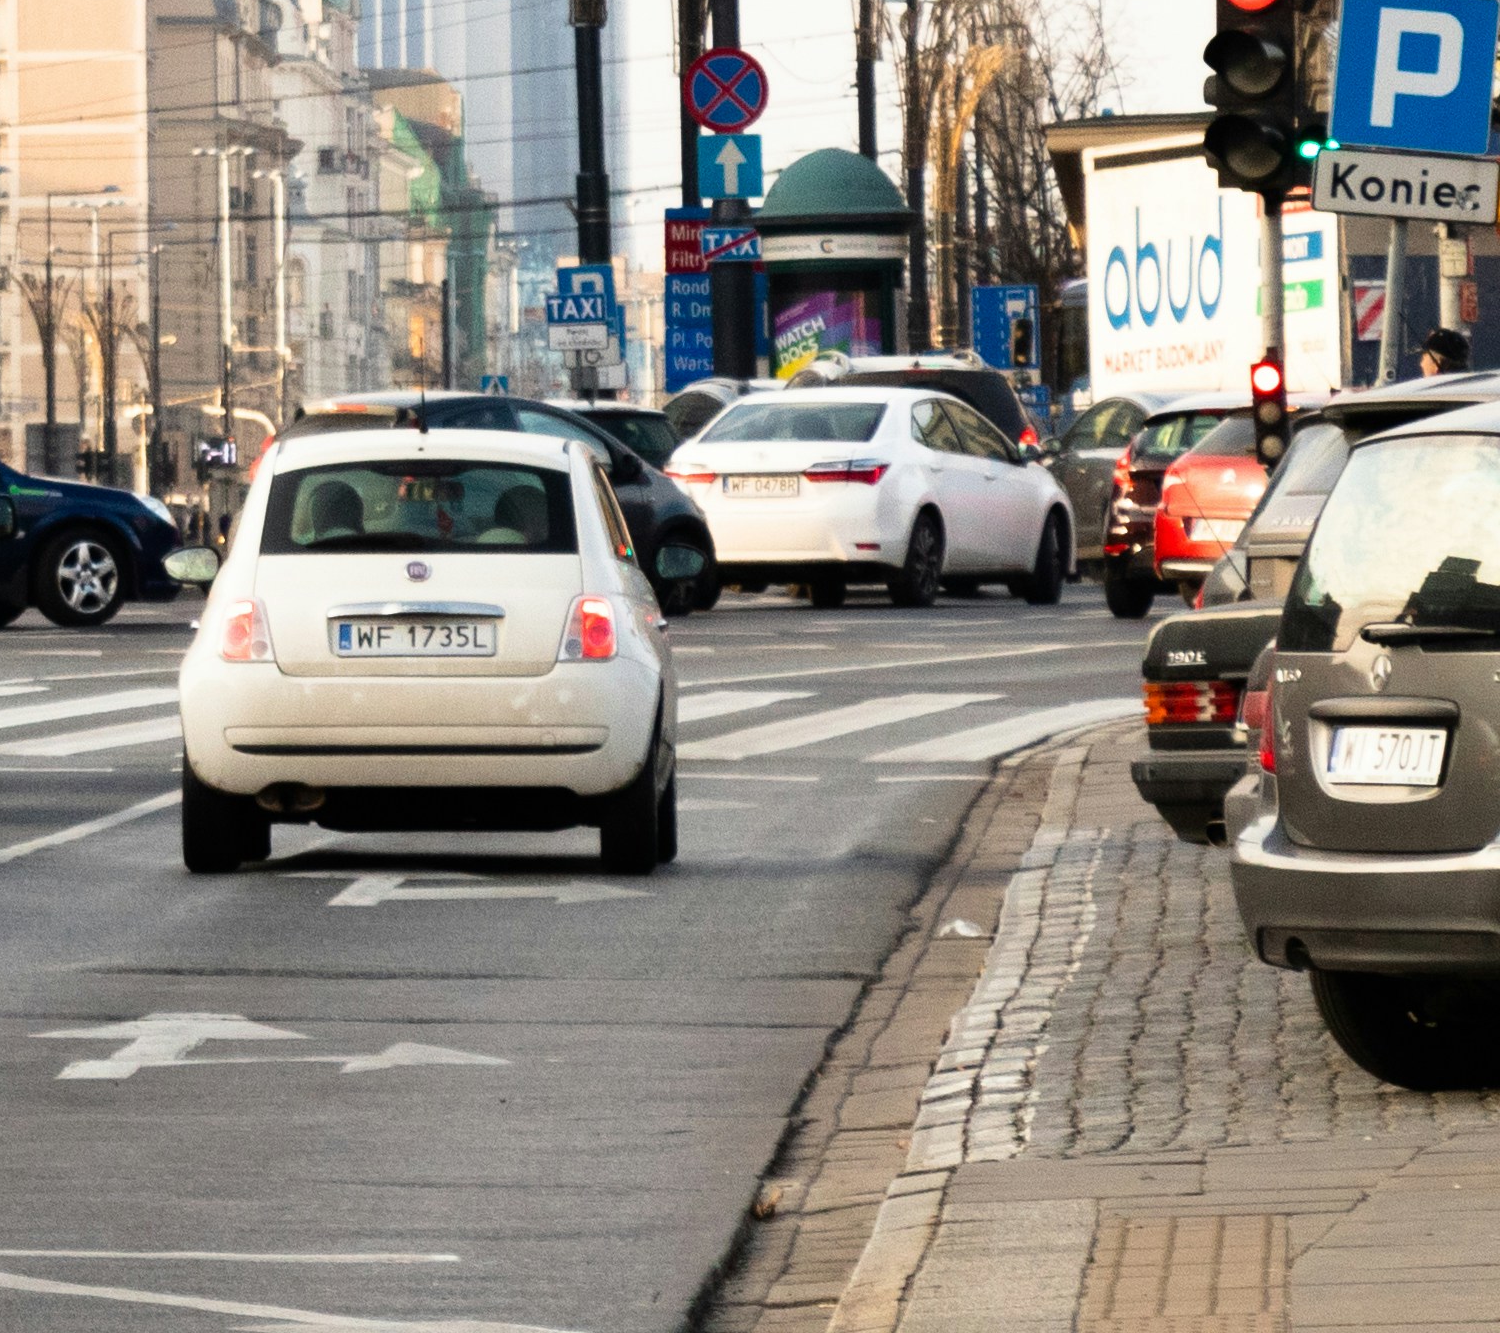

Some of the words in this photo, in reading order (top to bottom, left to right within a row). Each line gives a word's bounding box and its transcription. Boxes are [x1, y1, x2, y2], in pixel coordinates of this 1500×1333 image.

[1369, 6, 1465, 129] P
[704, 233, 763, 256] TAXI
[1104, 195, 1223, 331] abud
[672, 278, 710, 296] Rond
[548, 298, 603, 320] TAXI
[695, 331, 714, 349] Po
[775, 315, 826, 351] WATCH
[673, 355, 713, 372] Wars
[780, 337, 819, 366] DOCS
[1105, 348, 1152, 374] MARKET
[1156, 339, 1224, 370] BUDOWLANY
[357, 623, 394, 648] WF
[407, 623, 488, 650] 1735L
